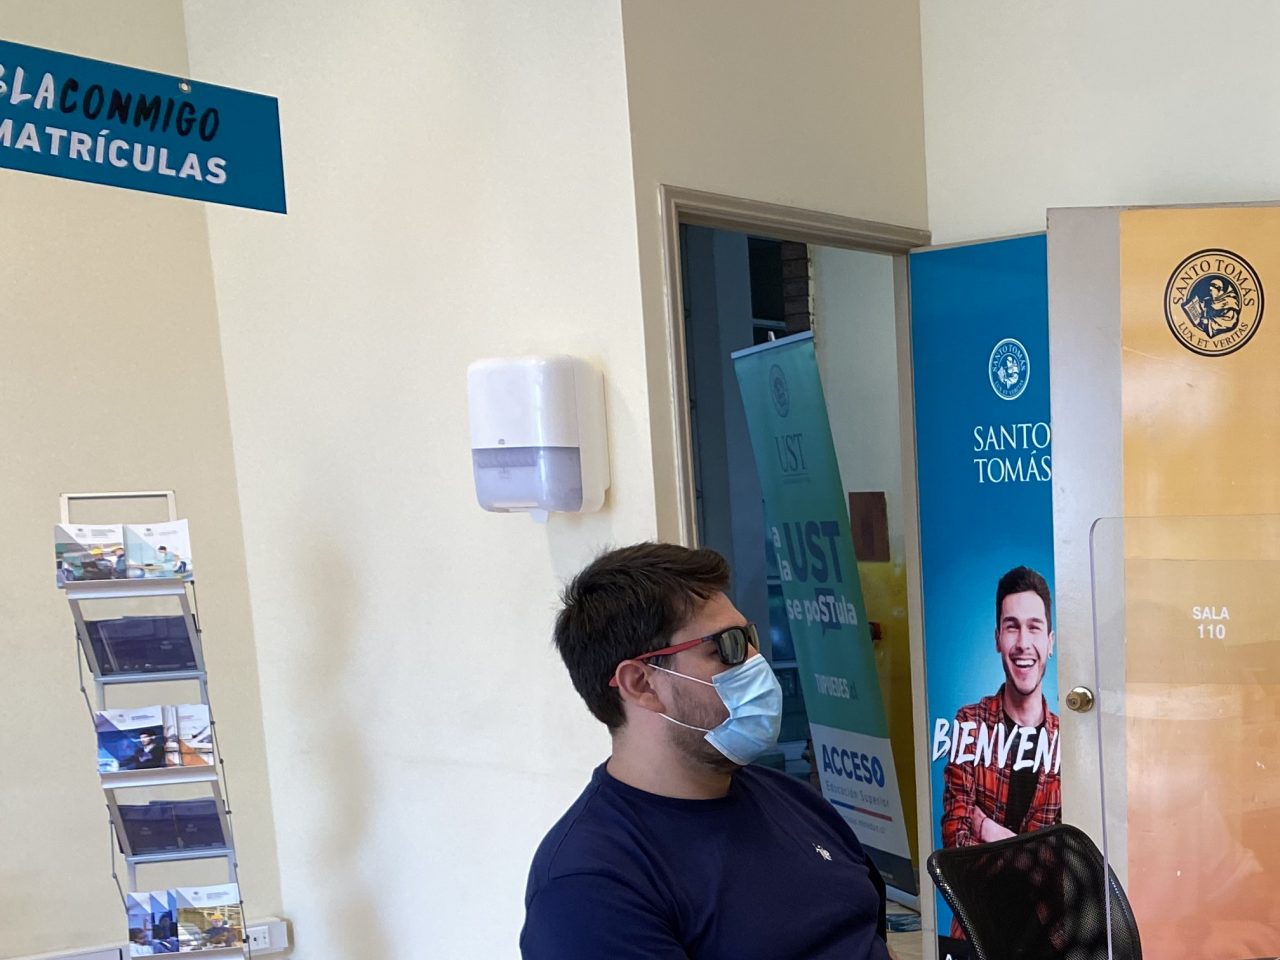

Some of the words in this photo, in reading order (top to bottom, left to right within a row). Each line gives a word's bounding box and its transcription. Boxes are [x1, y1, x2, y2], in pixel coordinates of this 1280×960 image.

[1173, 260, 1211, 305] SANTO
[1215, 259, 1256, 307] TOMÁS
[1178, 321, 1196, 342] LUX
[1197, 337, 1210, 348] ET
[1212, 321, 1249, 348] VERITAS
[973, 422, 1051, 452] SANTO
[774, 433, 807, 473] UST
[973, 450, 1052, 483] TOMÁS
[782, 520, 843, 584] UST
[777, 553, 793, 582] la
[786, 598, 802, 620] se
[1192, 606, 1230, 620] SALA
[1197, 623, 1226, 639] 110
[822, 743, 885, 788] ACCESO
